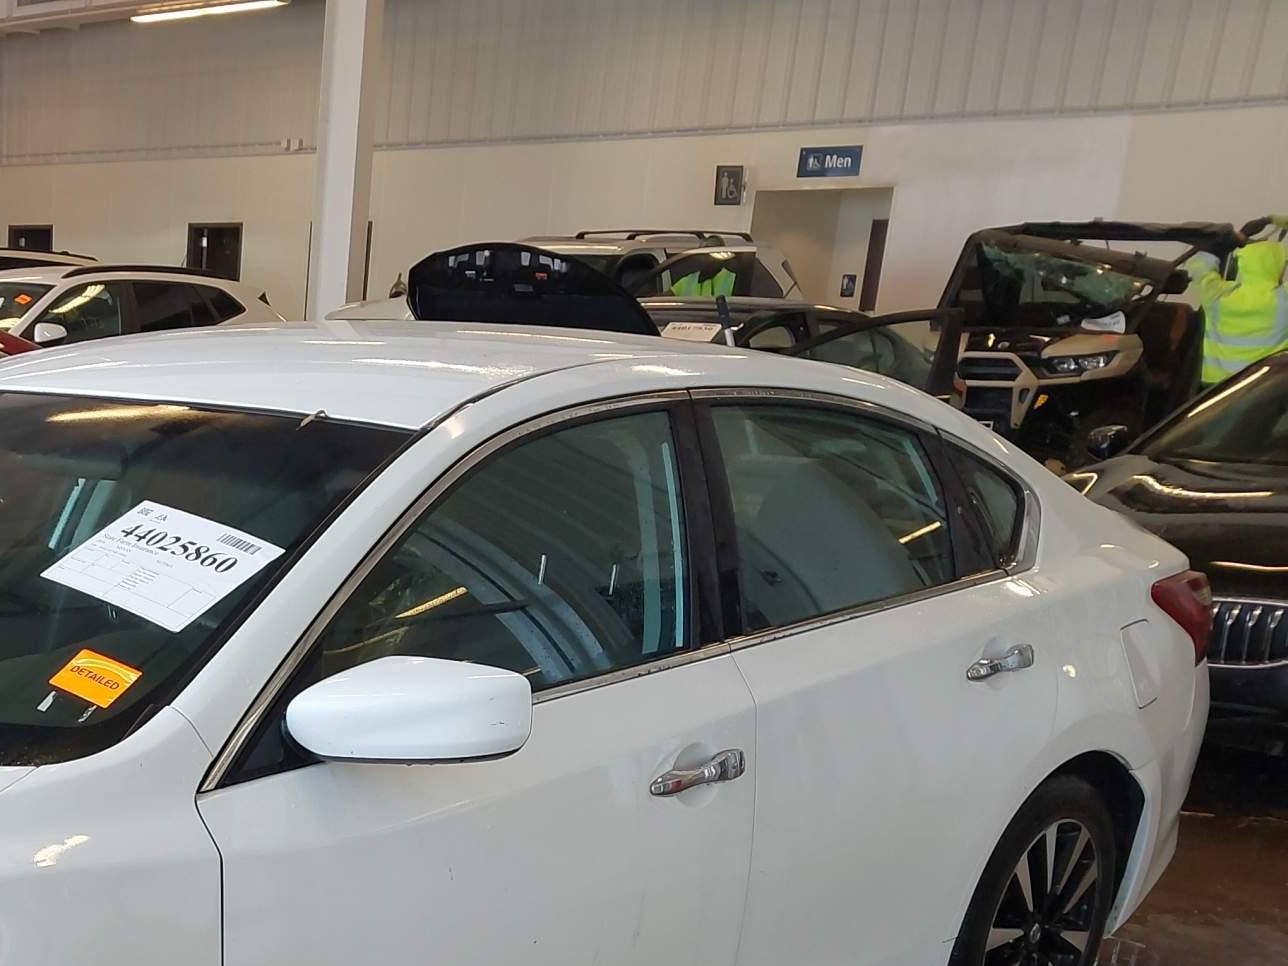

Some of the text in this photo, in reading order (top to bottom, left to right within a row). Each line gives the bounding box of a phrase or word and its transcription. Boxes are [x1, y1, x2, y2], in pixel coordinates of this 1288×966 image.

[824, 154, 852, 168] Men
[121, 524, 238, 573] 44025860
[70, 665, 120, 690] DETAILED
